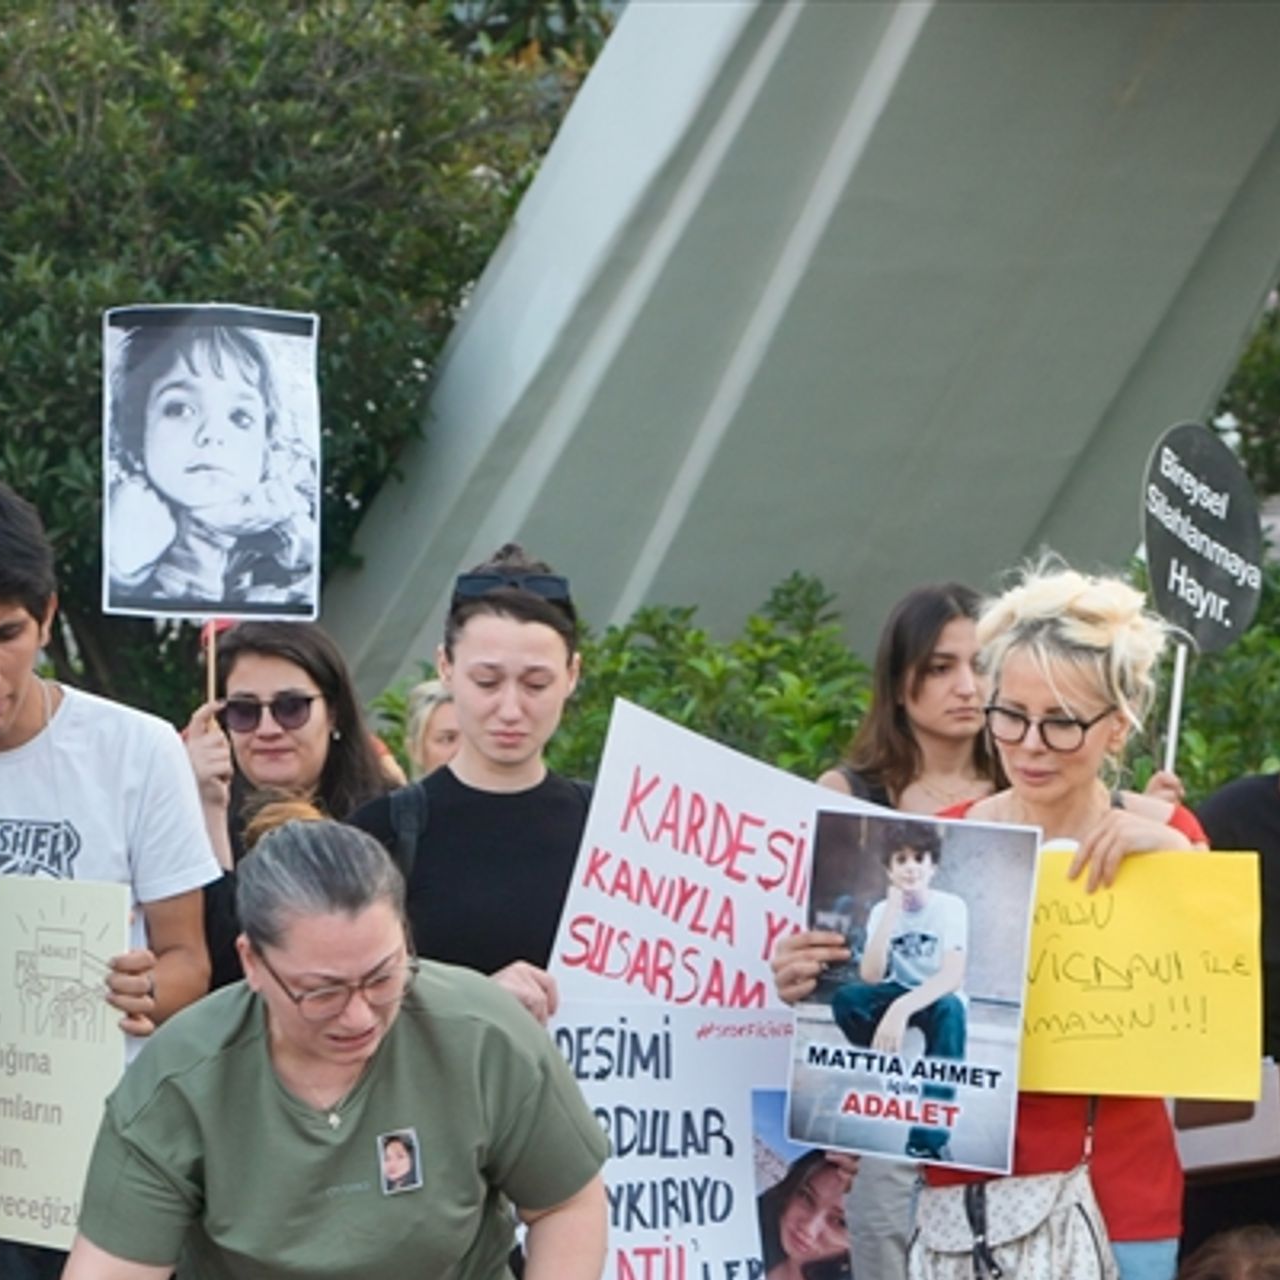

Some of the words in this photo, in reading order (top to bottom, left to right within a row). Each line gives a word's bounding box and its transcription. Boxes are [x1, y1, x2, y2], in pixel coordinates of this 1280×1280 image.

[1161, 446, 1229, 520] Bireysel
[1146, 483, 1262, 589] Silahlanmaya
[1168, 556, 1233, 628] Hayır.
[582, 847, 736, 947] KANIYLA
[561, 914, 767, 1009] SUSARSAM
[808, 1045, 906, 1080] MATTIA
[912, 1059, 1003, 1091] AHMET
[887, 1078, 919, 1099] için
[841, 1092, 960, 1128] ADALET
[605, 1175, 734, 1232] YKIRIYO
